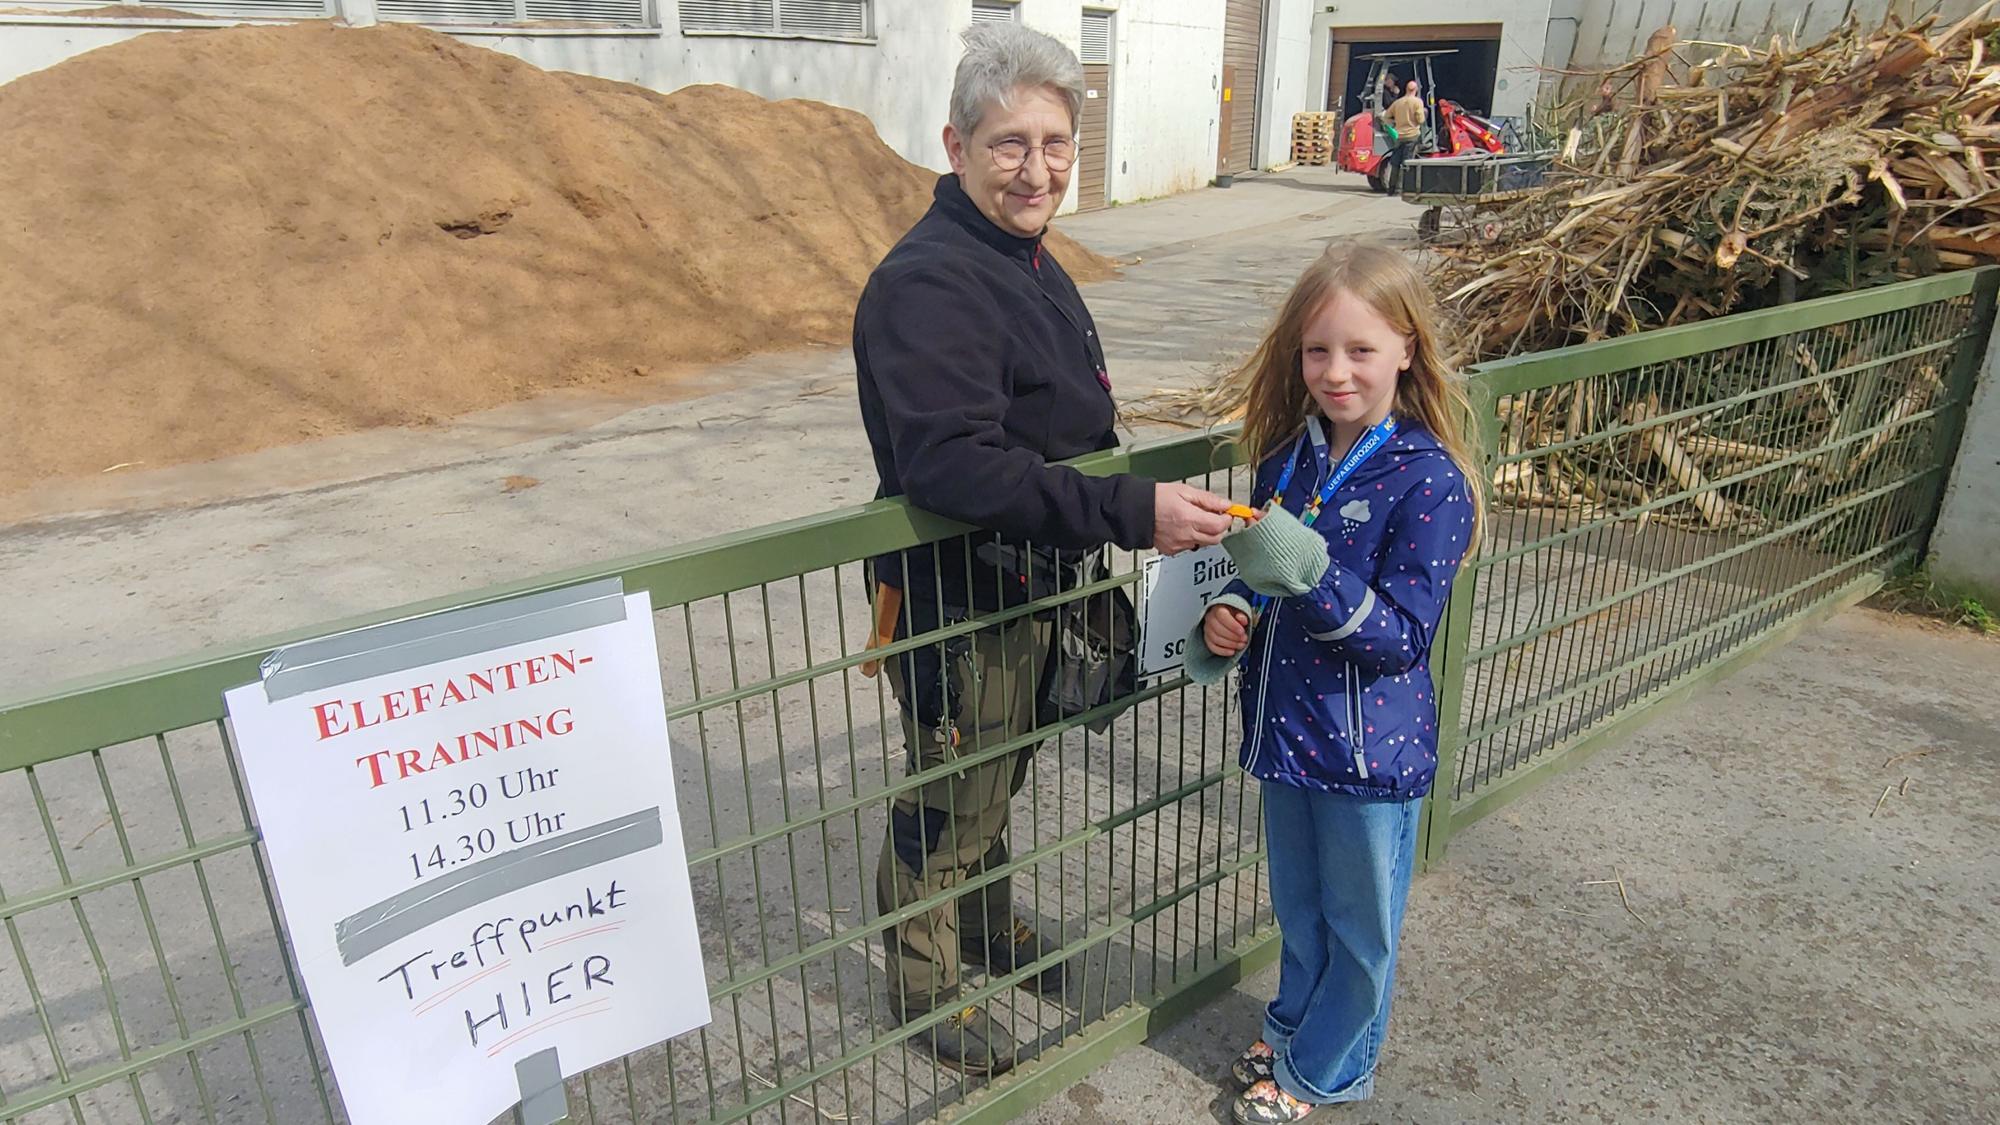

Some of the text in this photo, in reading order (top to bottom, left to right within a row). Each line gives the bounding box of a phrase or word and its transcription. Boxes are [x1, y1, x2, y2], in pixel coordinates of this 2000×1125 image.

[1193, 557, 1237, 586] Bitte
[309, 648, 594, 742] ELEFANTEN-
[356, 708, 576, 789] TRAINING
[399, 767, 560, 832] 11.30 Uhr
[407, 810, 567, 879] 14.30 Uhr
[377, 880, 627, 1001] Treffpunkt
[464, 955, 615, 1047] HIER
